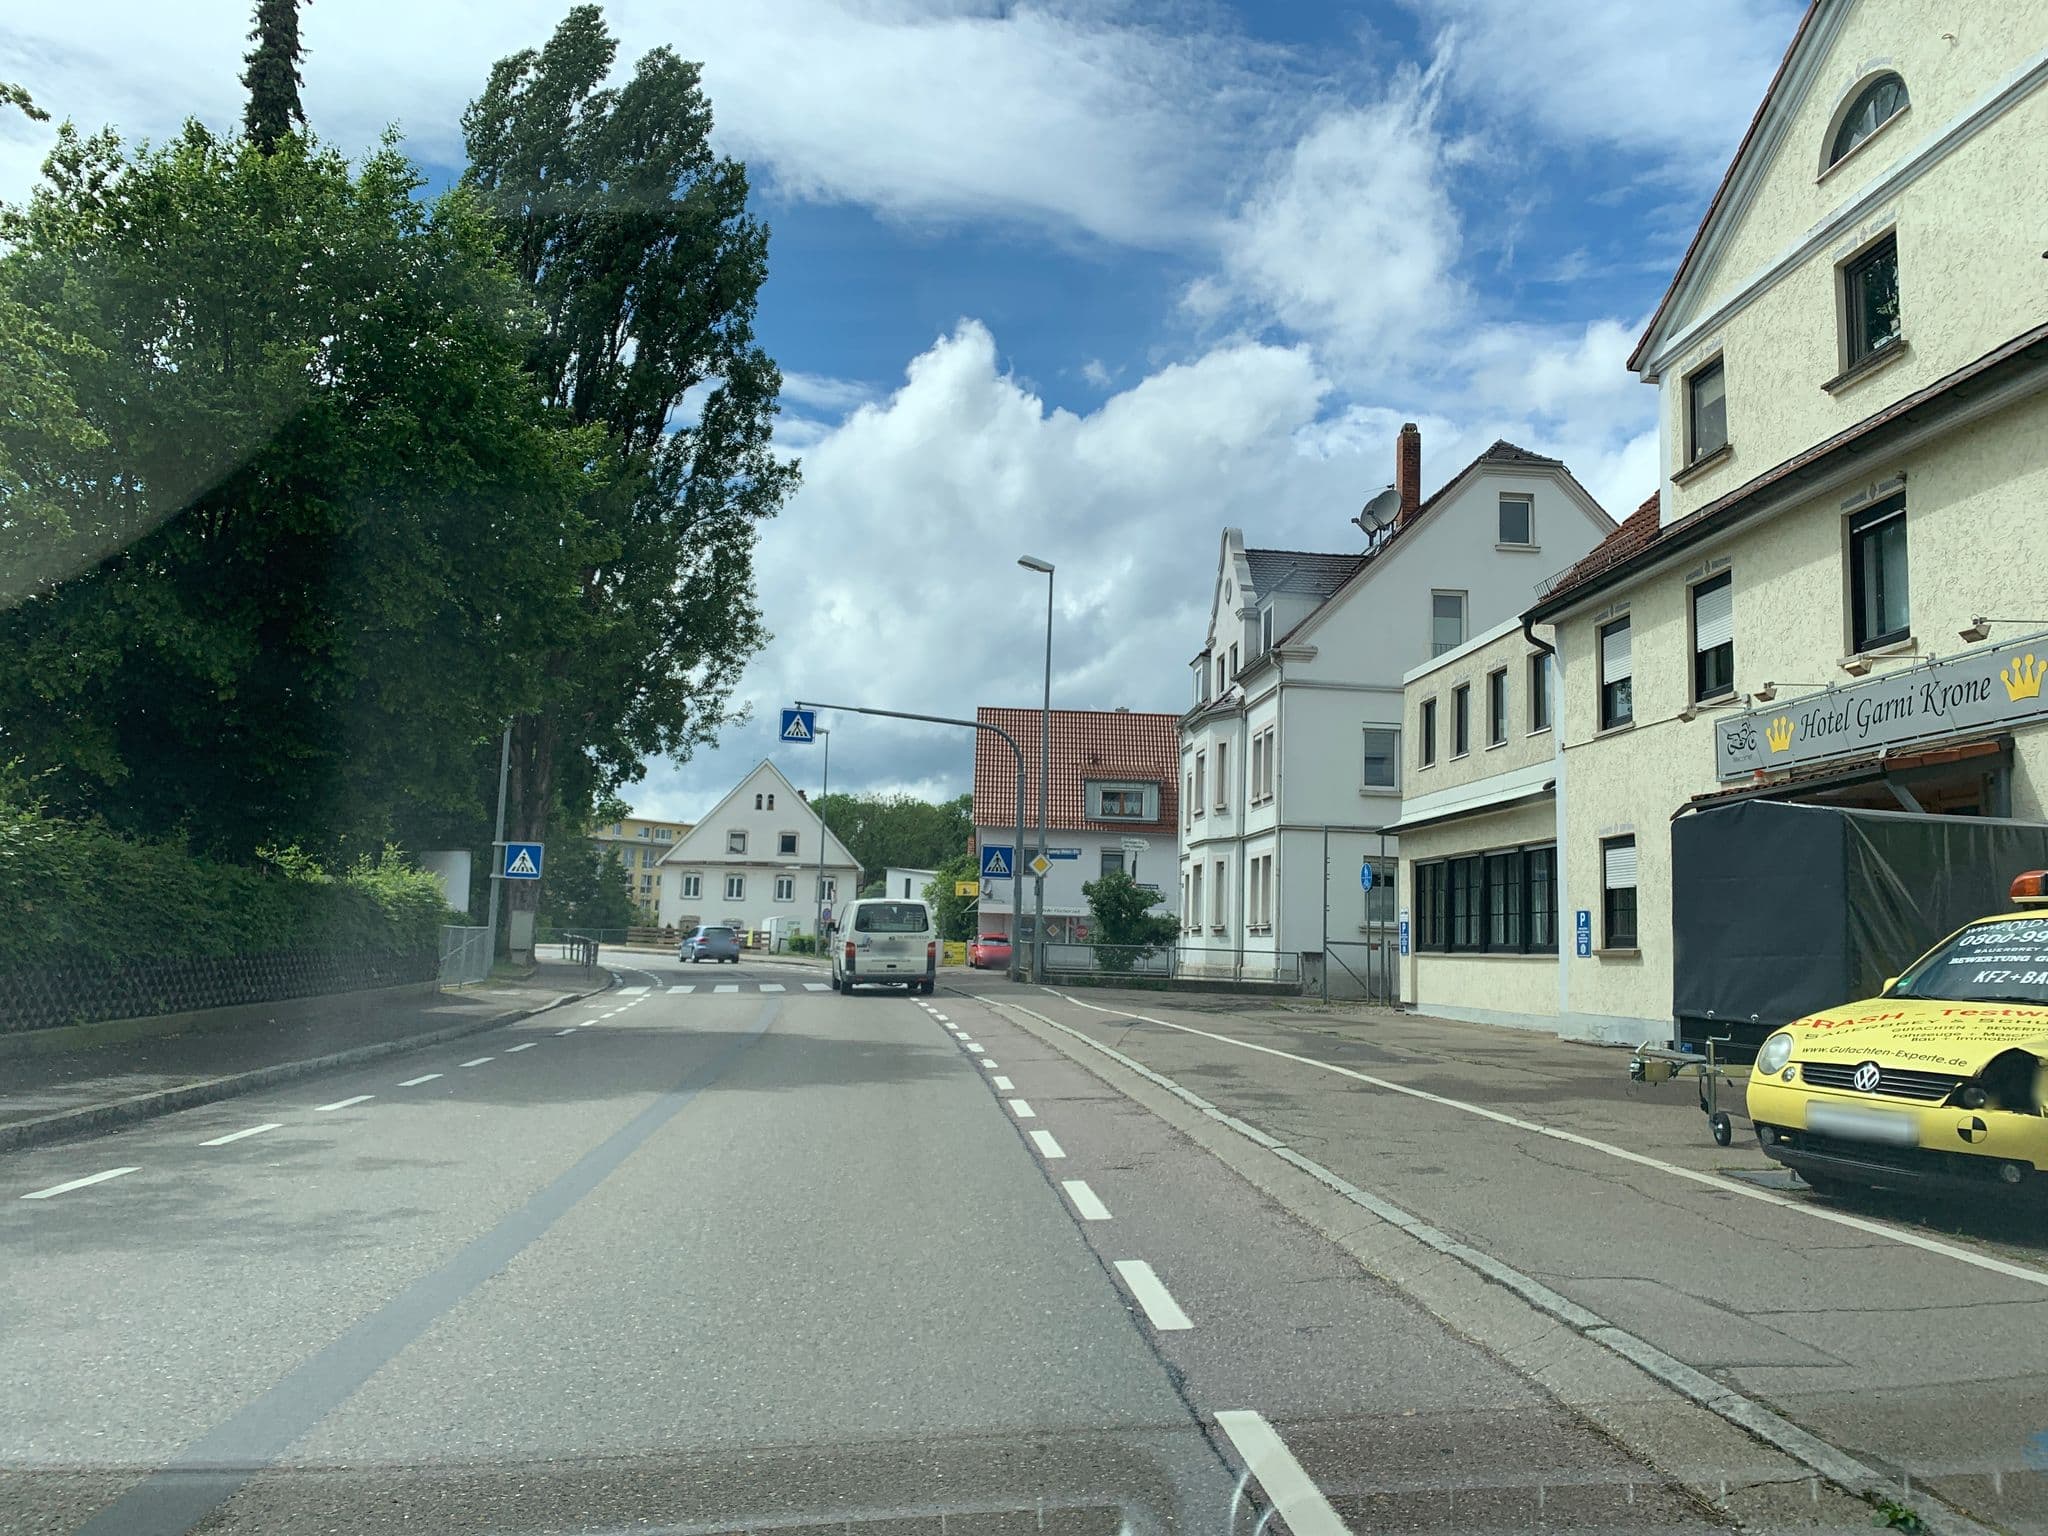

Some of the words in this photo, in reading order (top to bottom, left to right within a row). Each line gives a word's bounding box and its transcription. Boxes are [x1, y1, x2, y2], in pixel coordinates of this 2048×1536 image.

[1799, 698, 1853, 742] Hotel
[1856, 689, 1914, 738] Garni
[1919, 676, 1992, 717] Krone
[1966, 919, 2048, 934] www.OLD
[1948, 955, 2031, 965] BEWERTUNG
[1972, 970, 2048, 984] KFZ+BA
[1791, 1012, 1905, 1030] CRASH
[1940, 1009, 2048, 1017] Testw
[1804, 1018, 1940, 1040] SAUERBREY
[1891, 1025, 1966, 1033] GUTACHTEN
[1802, 1046, 1968, 1067] www.Gutachten-Experte.de
